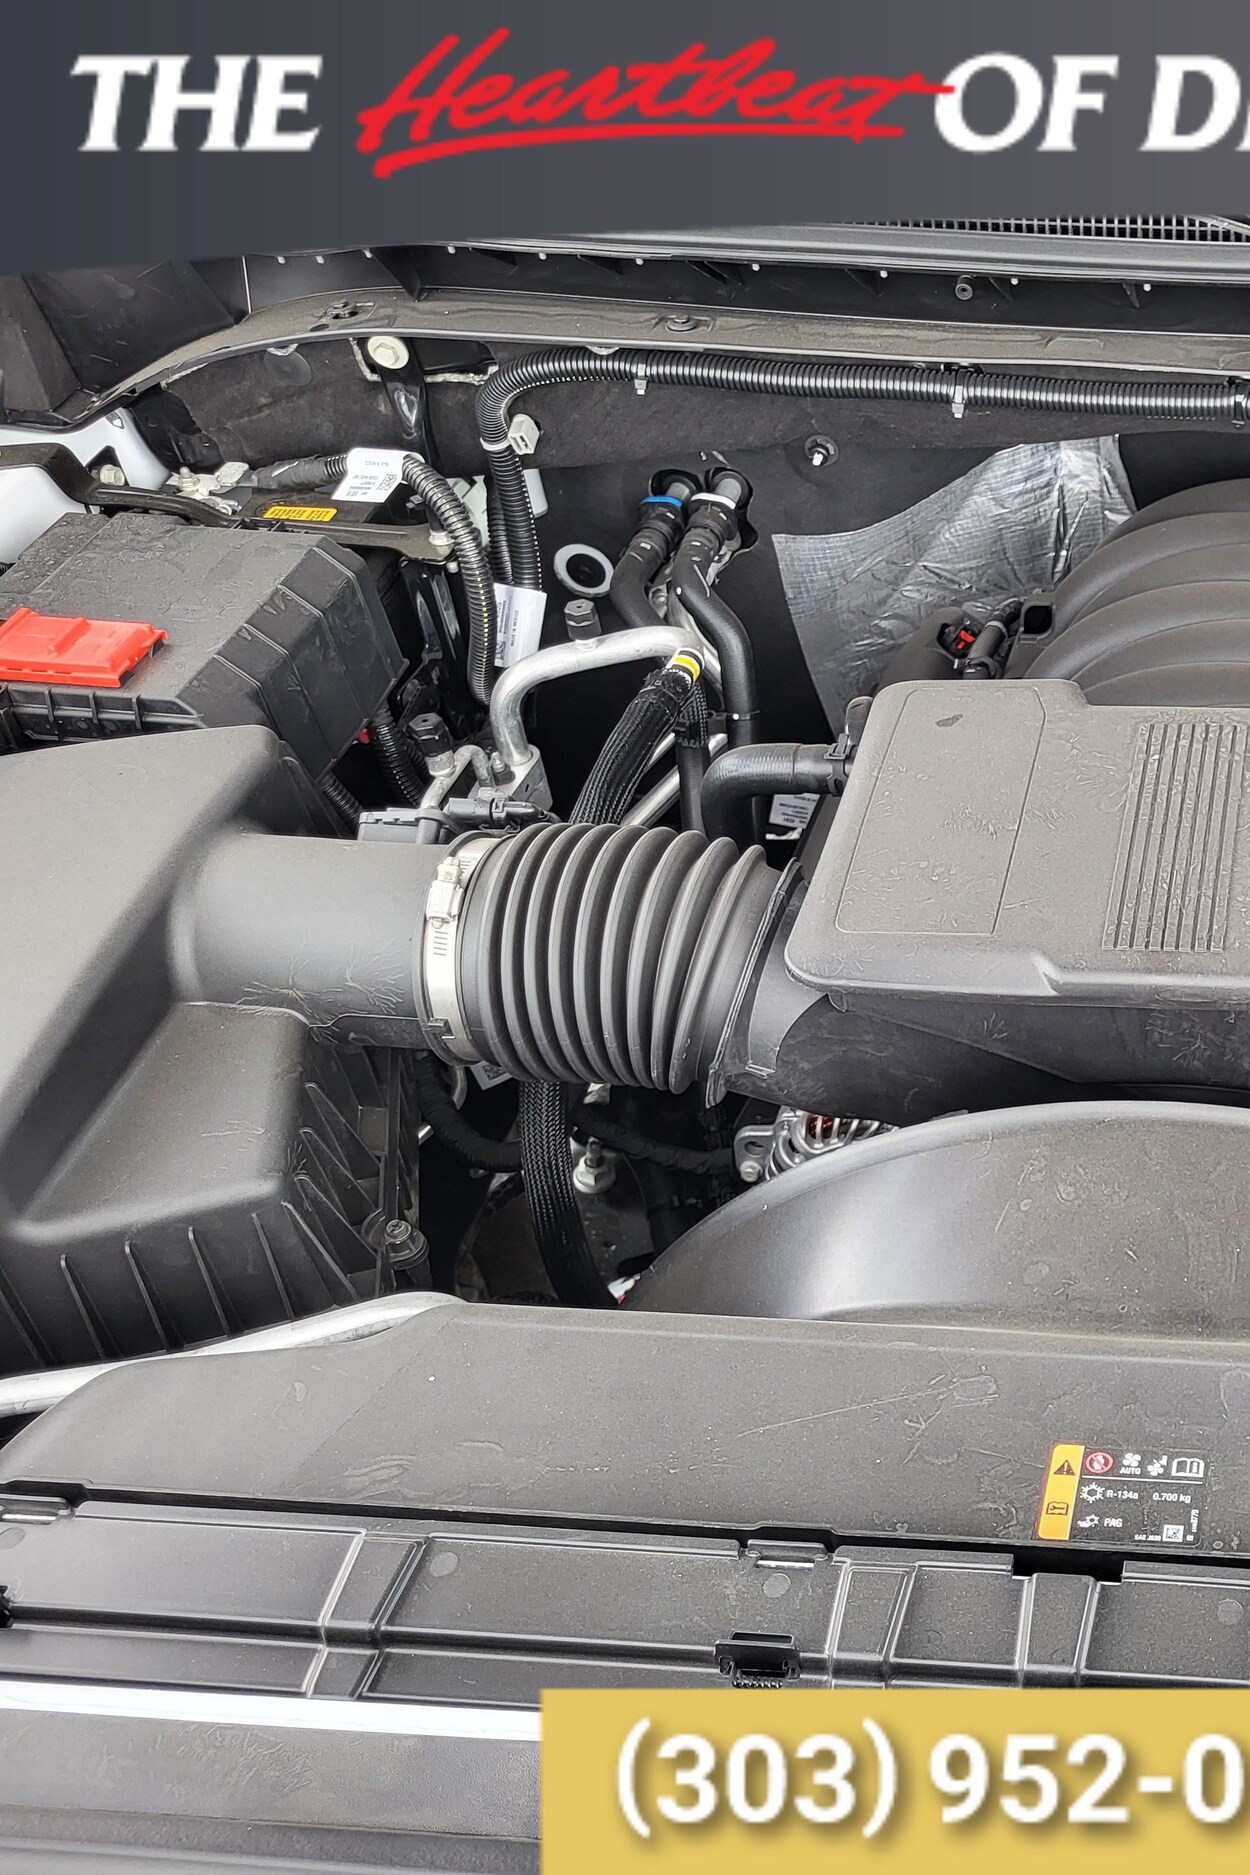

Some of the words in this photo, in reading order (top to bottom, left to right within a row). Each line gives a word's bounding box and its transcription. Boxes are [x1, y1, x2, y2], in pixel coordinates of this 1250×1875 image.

[1119, 1466, 1141, 1475] AUTO
[1106, 1489, 1139, 1500] R-134a
[1152, 1492, 1178, 1502] 0.700
[1179, 1493, 1191, 1504] kg
[1104, 1517, 1123, 1528] PAG
